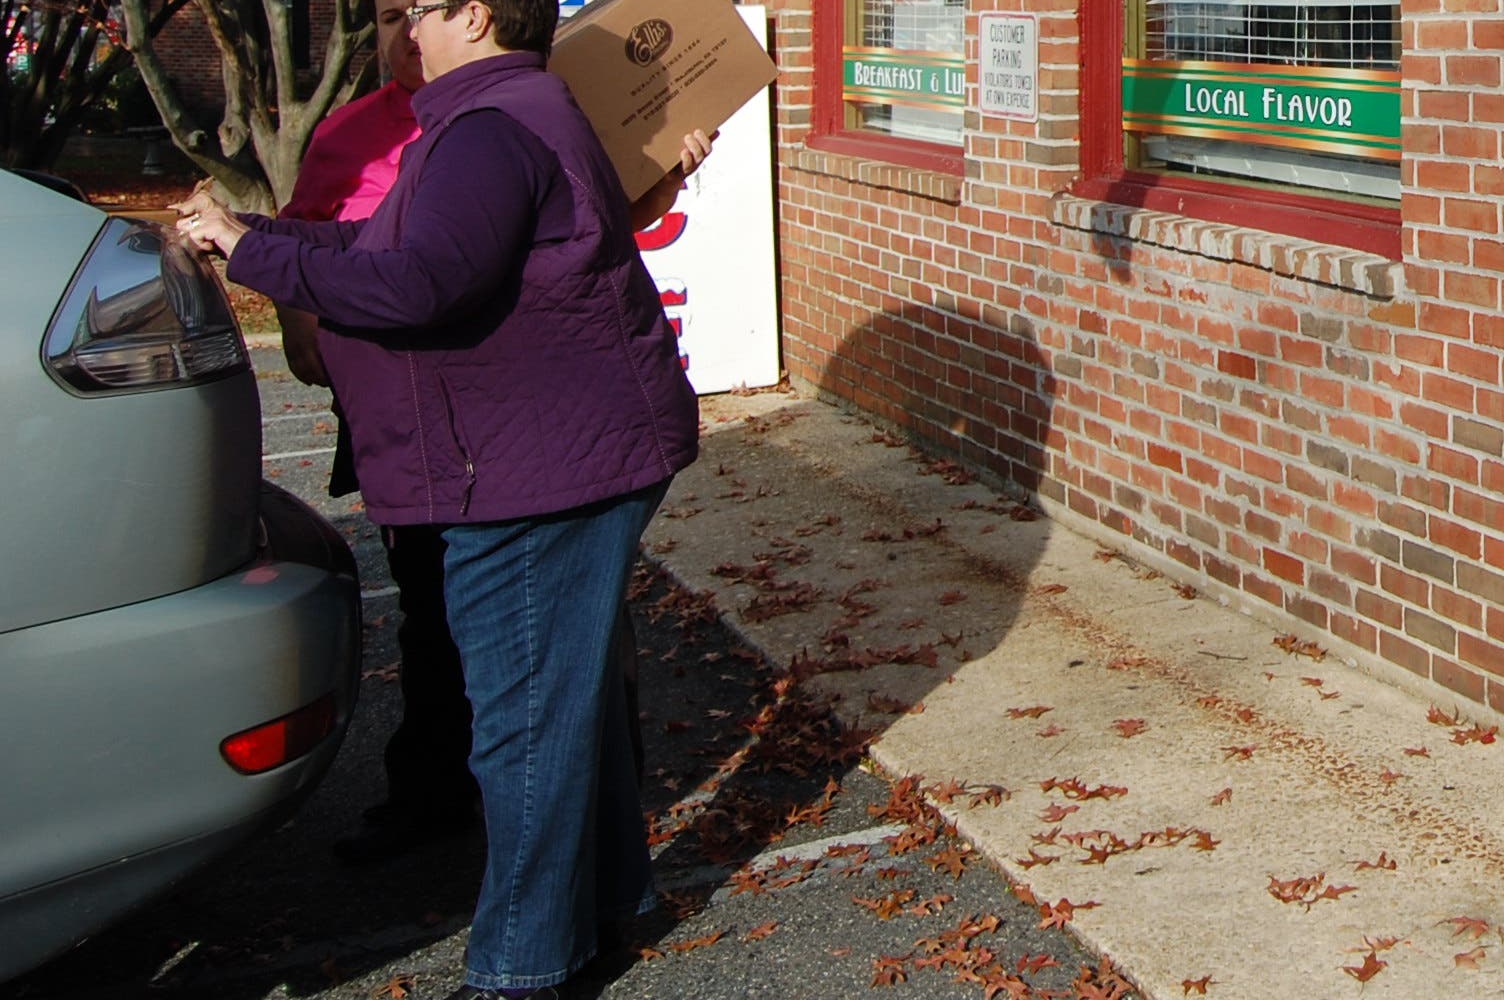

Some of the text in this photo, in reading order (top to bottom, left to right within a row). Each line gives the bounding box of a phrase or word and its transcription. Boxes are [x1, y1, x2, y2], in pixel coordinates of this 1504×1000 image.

[990, 23, 1025, 44] CUSTOMER
[992, 48, 1022, 69] PARKING
[854, 61, 923, 91] BREAKFAST
[1014, 74, 1033, 91] TOWED
[1185, 83, 1352, 127] LOCAL FLAVOR
